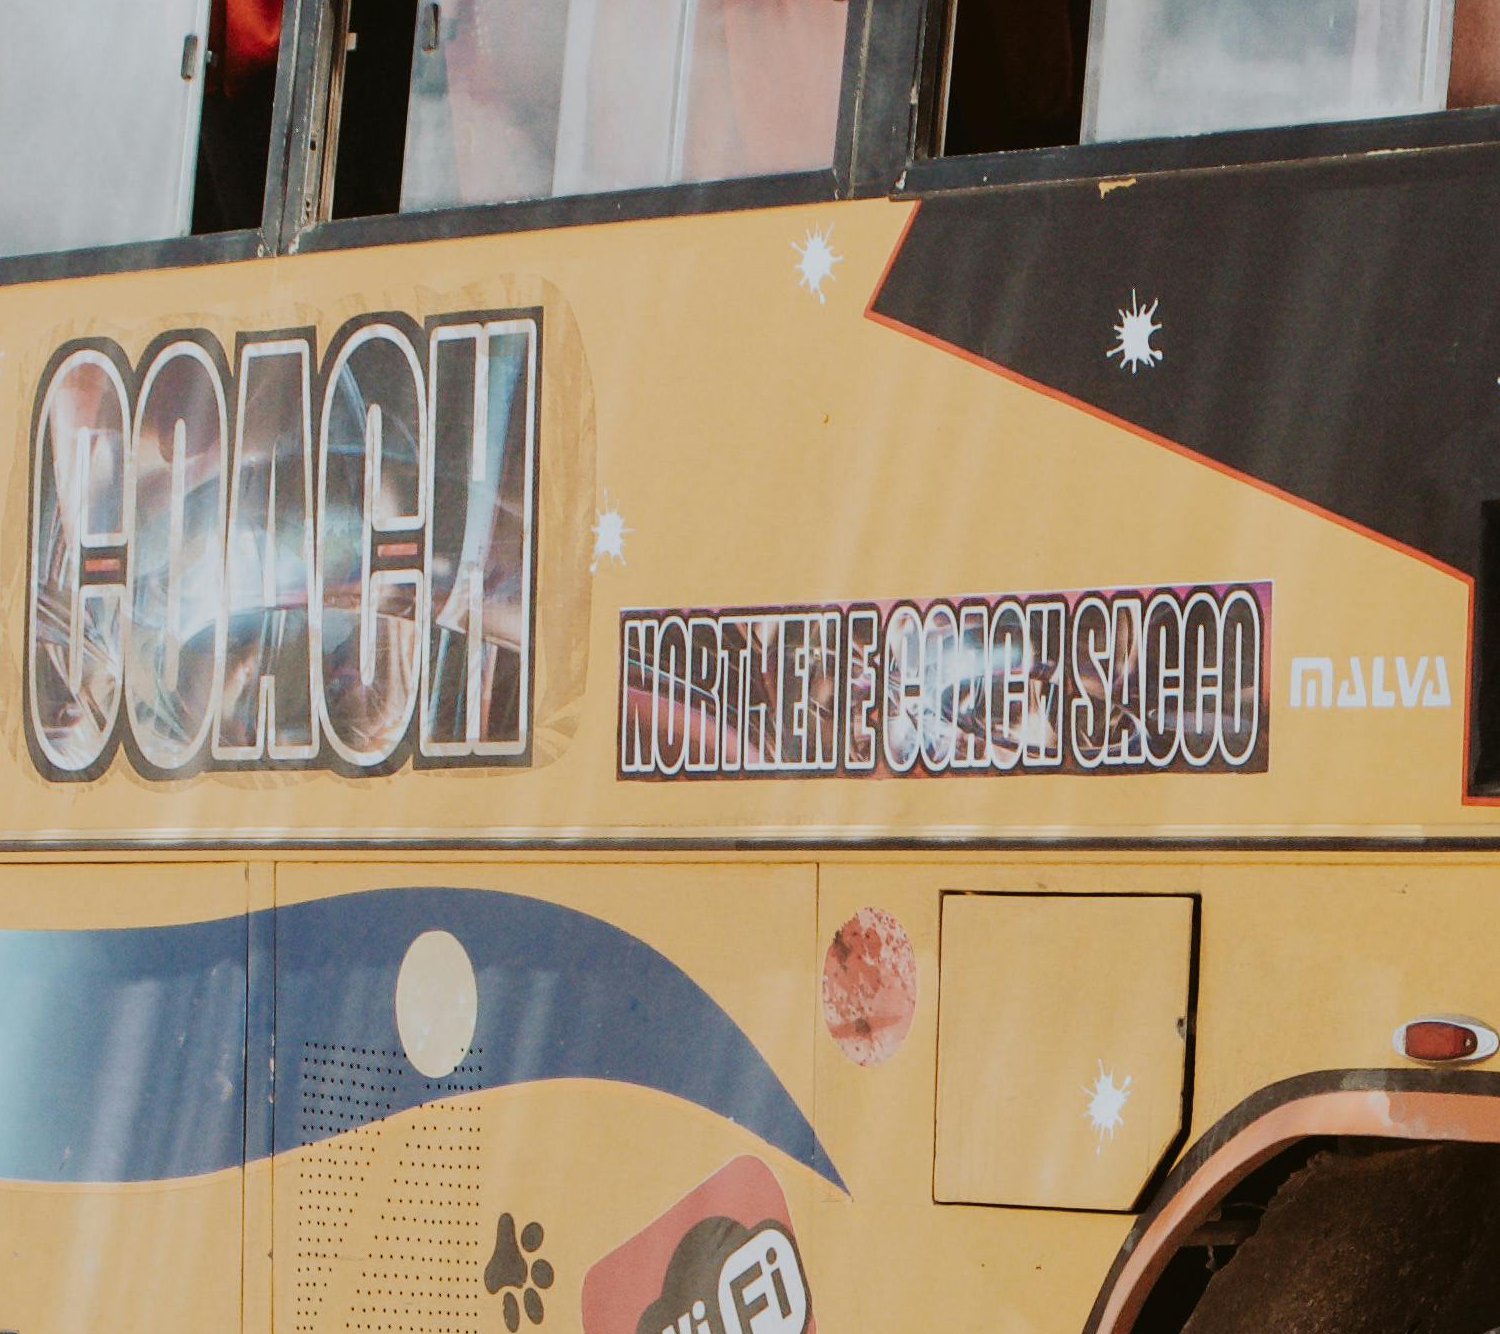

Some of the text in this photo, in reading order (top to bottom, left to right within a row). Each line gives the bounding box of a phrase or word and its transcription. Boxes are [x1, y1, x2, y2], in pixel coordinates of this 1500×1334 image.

[24, 311, 541, 778] COACH
[621, 589, 1261, 774] NORTHEN E COACH SACCO
[1288, 654, 1452, 709] MALVA
